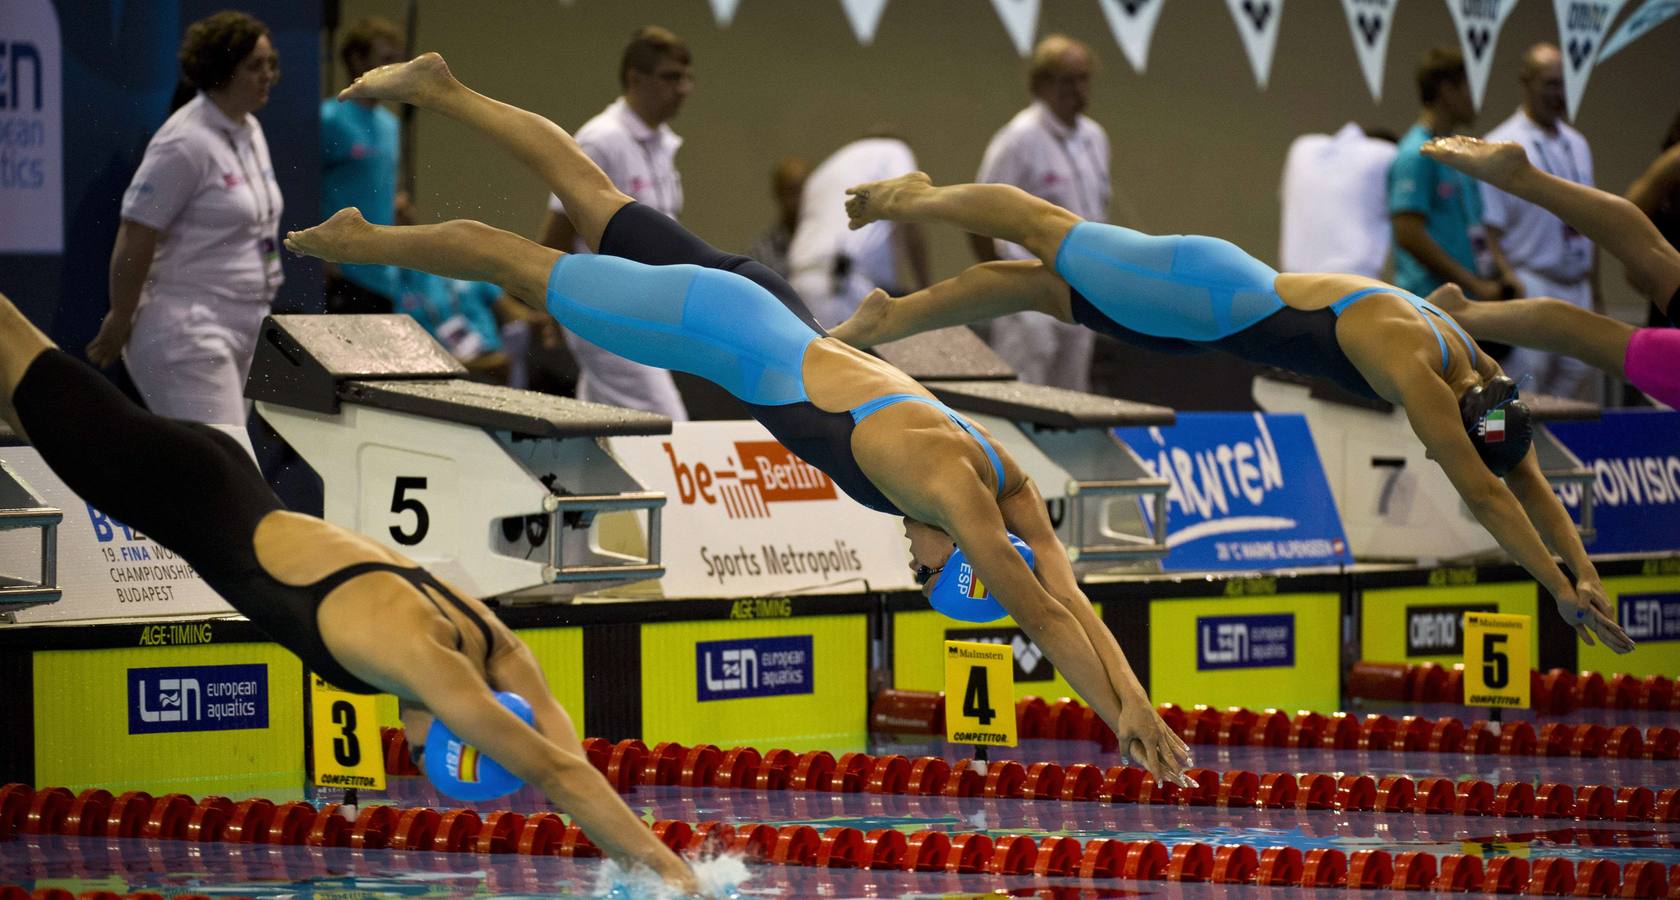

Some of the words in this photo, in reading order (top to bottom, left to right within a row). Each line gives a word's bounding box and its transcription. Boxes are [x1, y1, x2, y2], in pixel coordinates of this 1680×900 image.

[662, 442, 717, 505] be
[754, 454, 827, 492] Berlin
[1371, 457, 1408, 515] 7
[388, 476, 430, 546] 5
[102, 547, 120, 563] 19.
[120, 546, 151, 561] FINA
[151, 545, 181, 560] WO
[700, 546, 761, 585] Sports
[763, 540, 862, 580] Metropolis
[110, 564, 201, 583] CHAMPIONSHIP
[957, 561, 972, 596] ESP
[116, 585, 174, 604] BUDAPEST
[139, 622, 212, 646] ALGE-TIMING
[1410, 614, 1456, 649] arena
[959, 649, 1004, 661] Malmsten
[1483, 634, 1509, 689] 5
[207, 681, 257, 697] european
[963, 666, 996, 725] 4
[1470, 695, 1520, 704] COMPETITOR
[207, 701, 255, 719] aquatics
[332, 700, 361, 767] 3
[953, 731, 1008, 743] COMPETITOR
[321, 773, 376, 786] COMPETITOR
